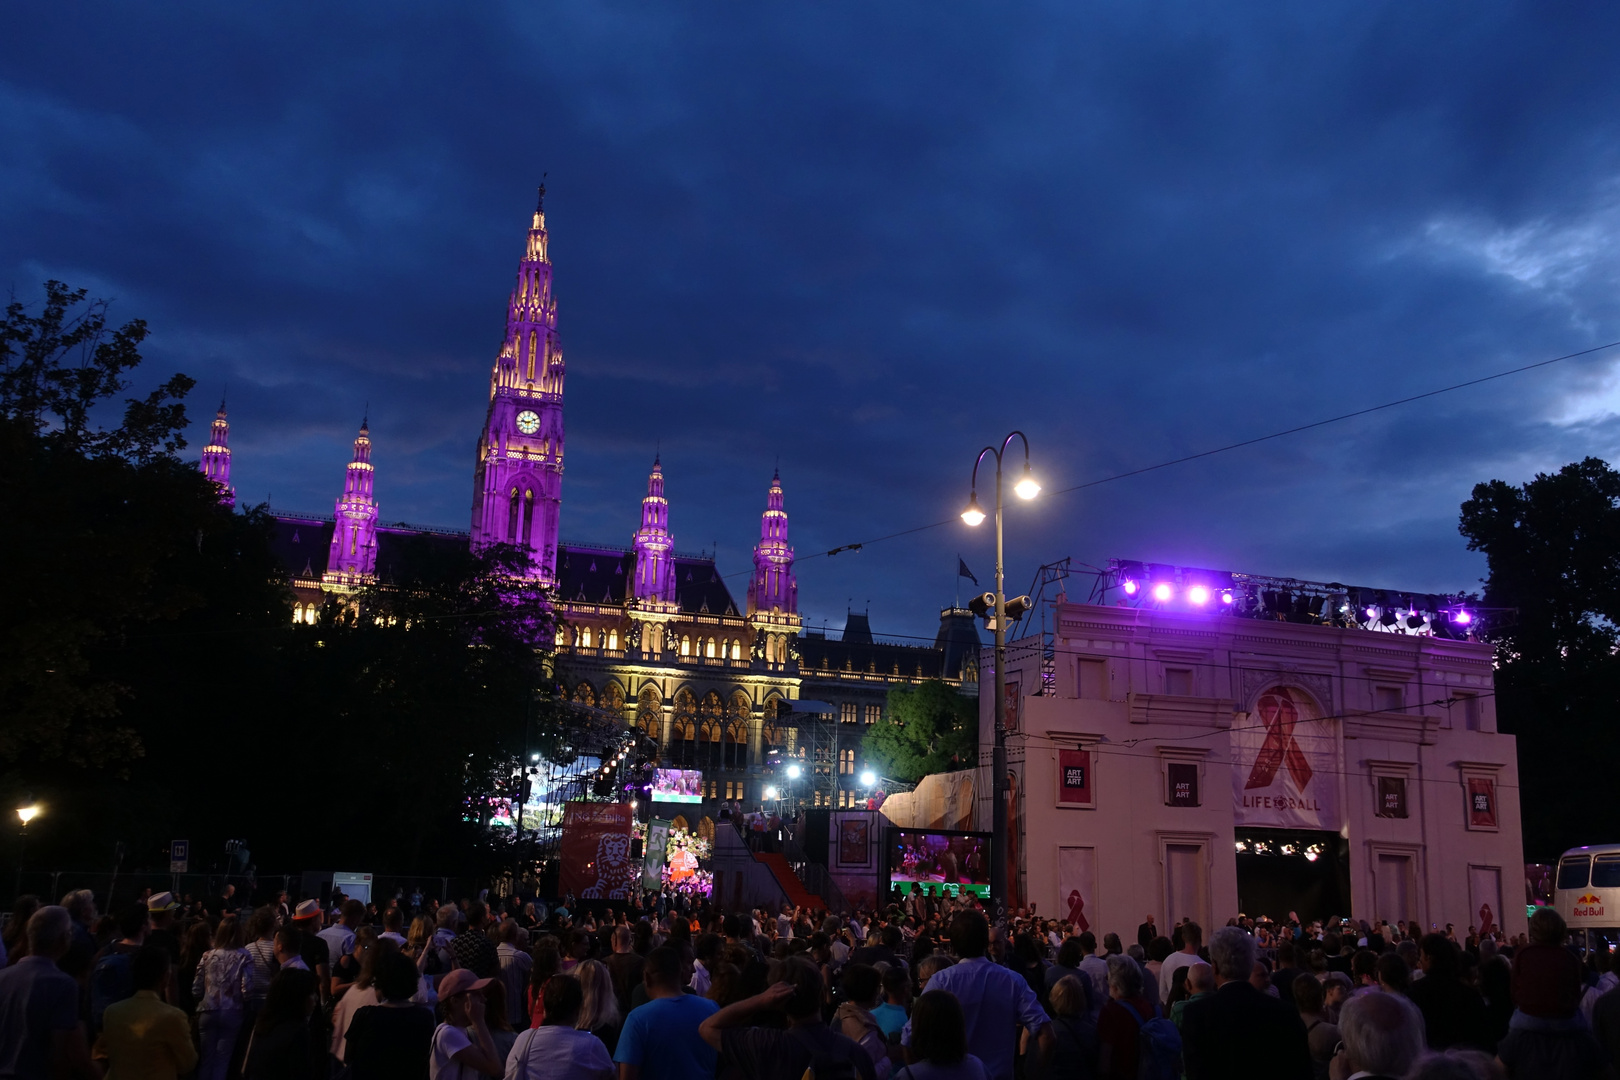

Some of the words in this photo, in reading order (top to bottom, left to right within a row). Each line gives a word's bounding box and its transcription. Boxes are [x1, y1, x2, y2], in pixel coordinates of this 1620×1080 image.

[1175, 782, 1190, 790] ART
[1243, 795, 1271, 809] LIFE
[1288, 797, 1321, 811] BALL
[1573, 907, 1588, 917] Red
[1589, 906, 1604, 916] Bull
